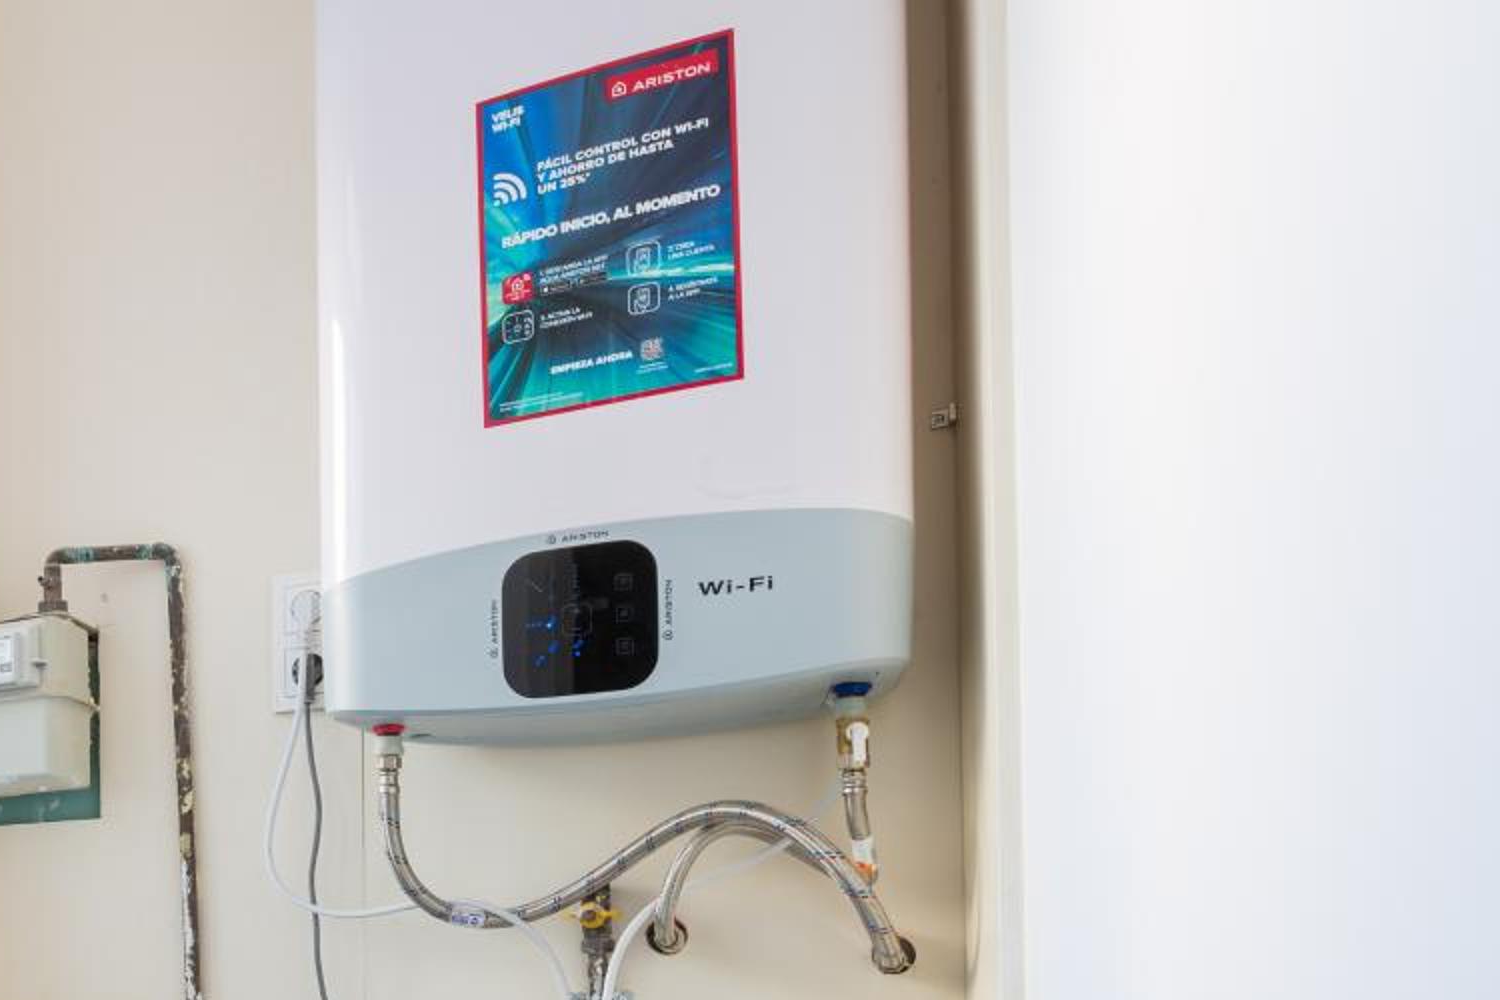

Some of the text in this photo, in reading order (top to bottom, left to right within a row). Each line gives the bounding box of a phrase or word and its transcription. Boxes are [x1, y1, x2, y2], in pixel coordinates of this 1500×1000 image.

[631, 61, 712, 93] ARISTON
[575, 137, 638, 161] CONTROL
[641, 127, 671, 144] CON
[673, 117, 709, 135] WI-FI
[537, 139, 675, 183] Y AHORRO DE HASTA
[537, 181, 557, 194] UN
[501, 224, 558, 249] RÁPIDO
[613, 205, 633, 222] AL
[635, 183, 721, 215] MOMENTO
[698, 575, 775, 597] Wi-Fi
